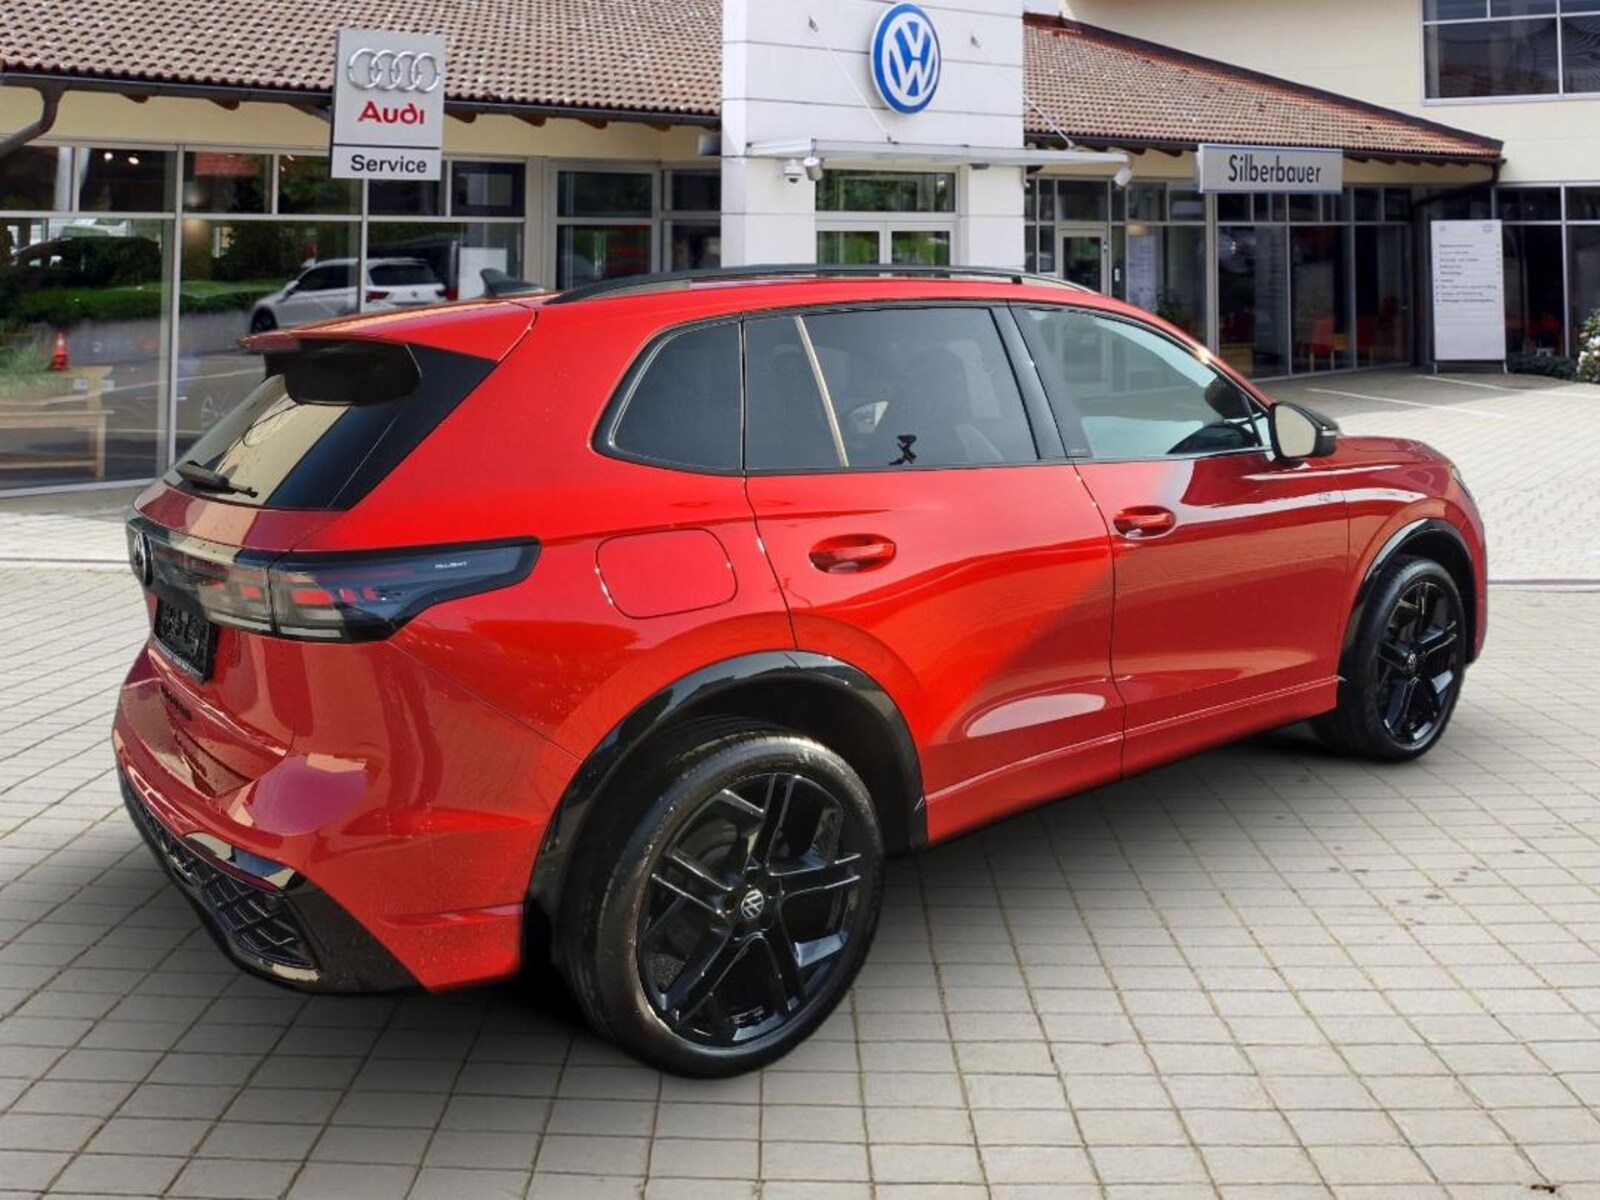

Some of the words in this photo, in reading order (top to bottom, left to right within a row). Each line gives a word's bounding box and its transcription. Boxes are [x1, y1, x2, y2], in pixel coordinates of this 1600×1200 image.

[358, 100, 425, 125] Audi
[350, 154, 427, 173] Service
[1228, 154, 1321, 183] Silberbauer
